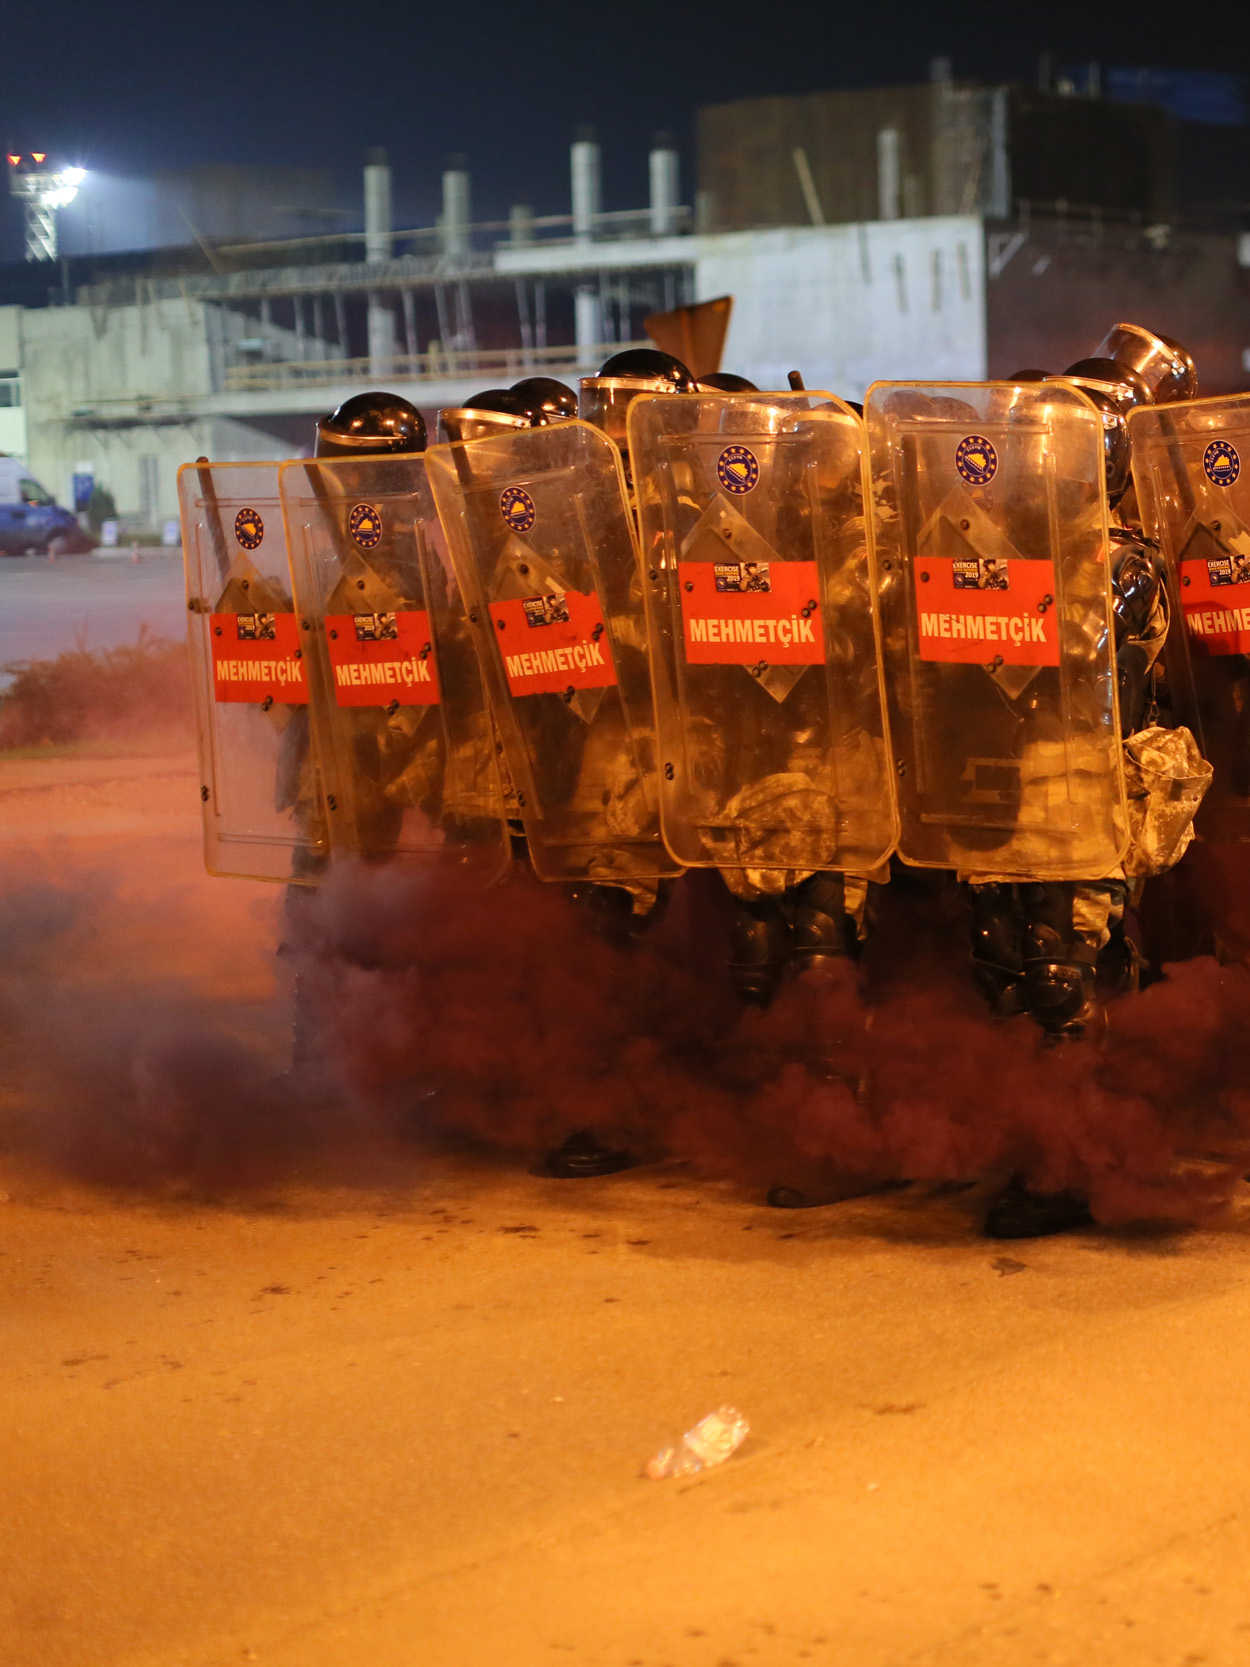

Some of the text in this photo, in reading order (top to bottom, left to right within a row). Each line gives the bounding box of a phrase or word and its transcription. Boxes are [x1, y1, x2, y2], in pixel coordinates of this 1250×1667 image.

[953, 561, 978, 569] EXERCISE
[1207, 560, 1230, 569] EXERCISE
[689, 614, 816, 648] MEHMETÇİK
[921, 612, 1047, 647] MEHMETÇİK
[216, 656, 303, 686] MEHMETÇİK
[335, 656, 431, 687] MEHMETÇİK
[505, 640, 606, 678] MEHMETÇİK
